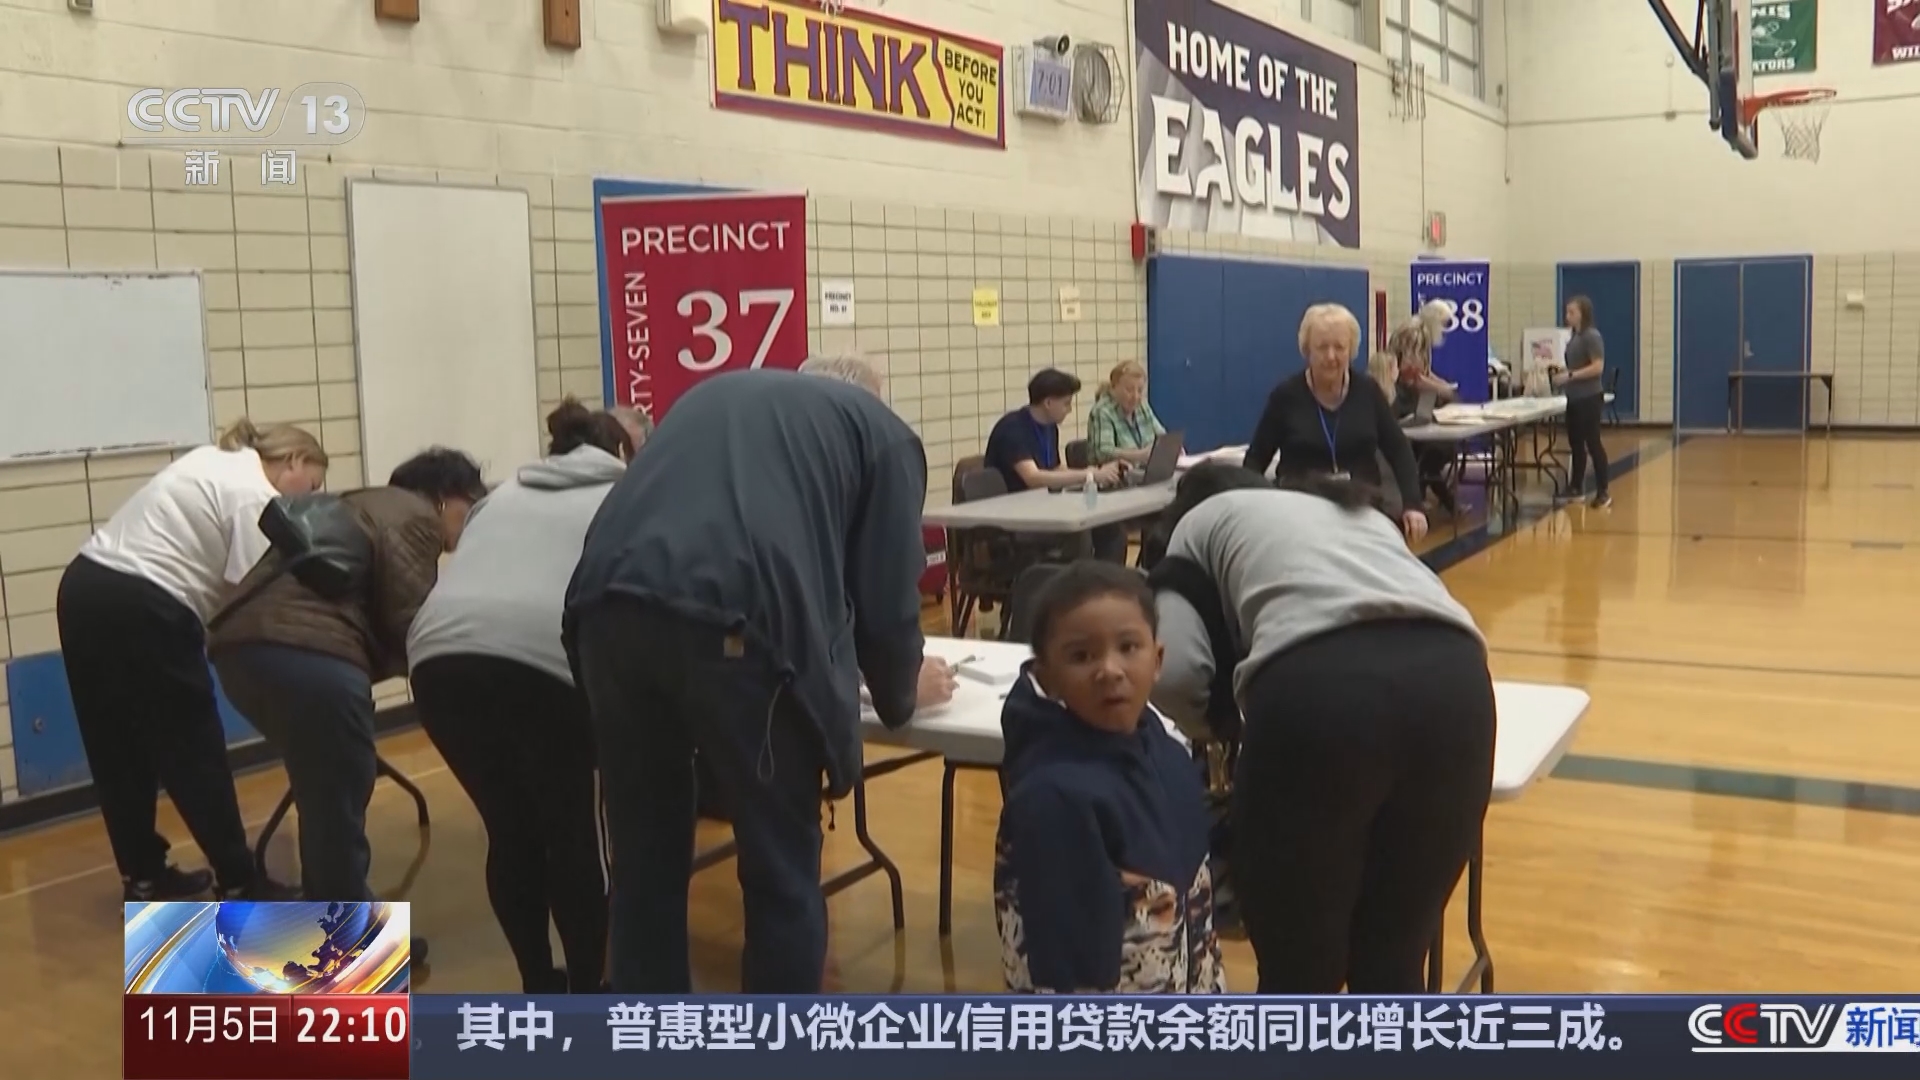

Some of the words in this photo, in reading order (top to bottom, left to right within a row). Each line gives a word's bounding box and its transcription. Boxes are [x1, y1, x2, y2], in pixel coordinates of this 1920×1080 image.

[720, 1, 931, 118] THINK
[944, 48, 997, 84] BEFORE
[1167, 21, 1250, 92] HOME
[1258, 54, 1289, 101] OF
[1295, 66, 1338, 120] THE
[958, 78, 984, 104] YOU
[1036, 68, 1066, 97] 7:01
[1151, 95, 1351, 220] EAGLES
[621, 221, 791, 256] PRECINCT
[1417, 272, 1484, 286] PRECINCT
[676, 289, 795, 372] 37
